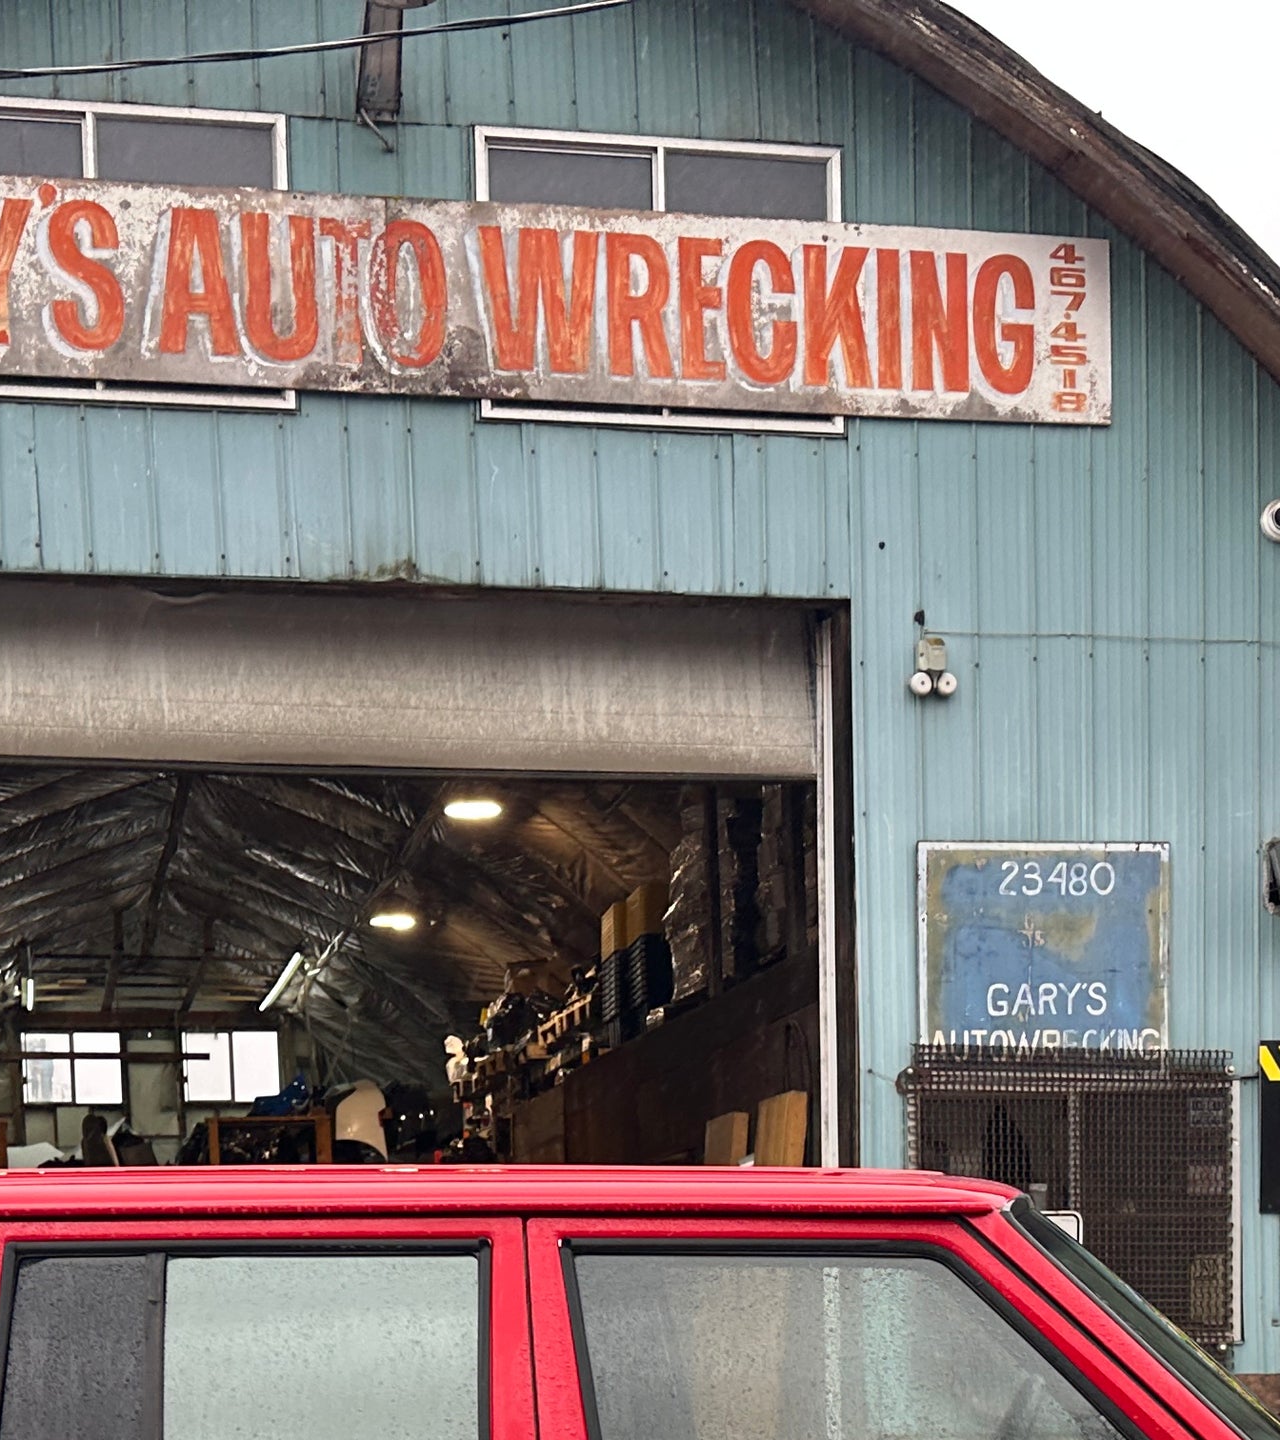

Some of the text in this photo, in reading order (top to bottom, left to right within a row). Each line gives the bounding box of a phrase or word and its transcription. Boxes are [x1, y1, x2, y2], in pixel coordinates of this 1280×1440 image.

[157, 206, 448, 369] AUTO
[477, 223, 1036, 396] WRECKING
[998, 861, 1116, 896] 23480
[986, 982, 1108, 1017] GARY'S
